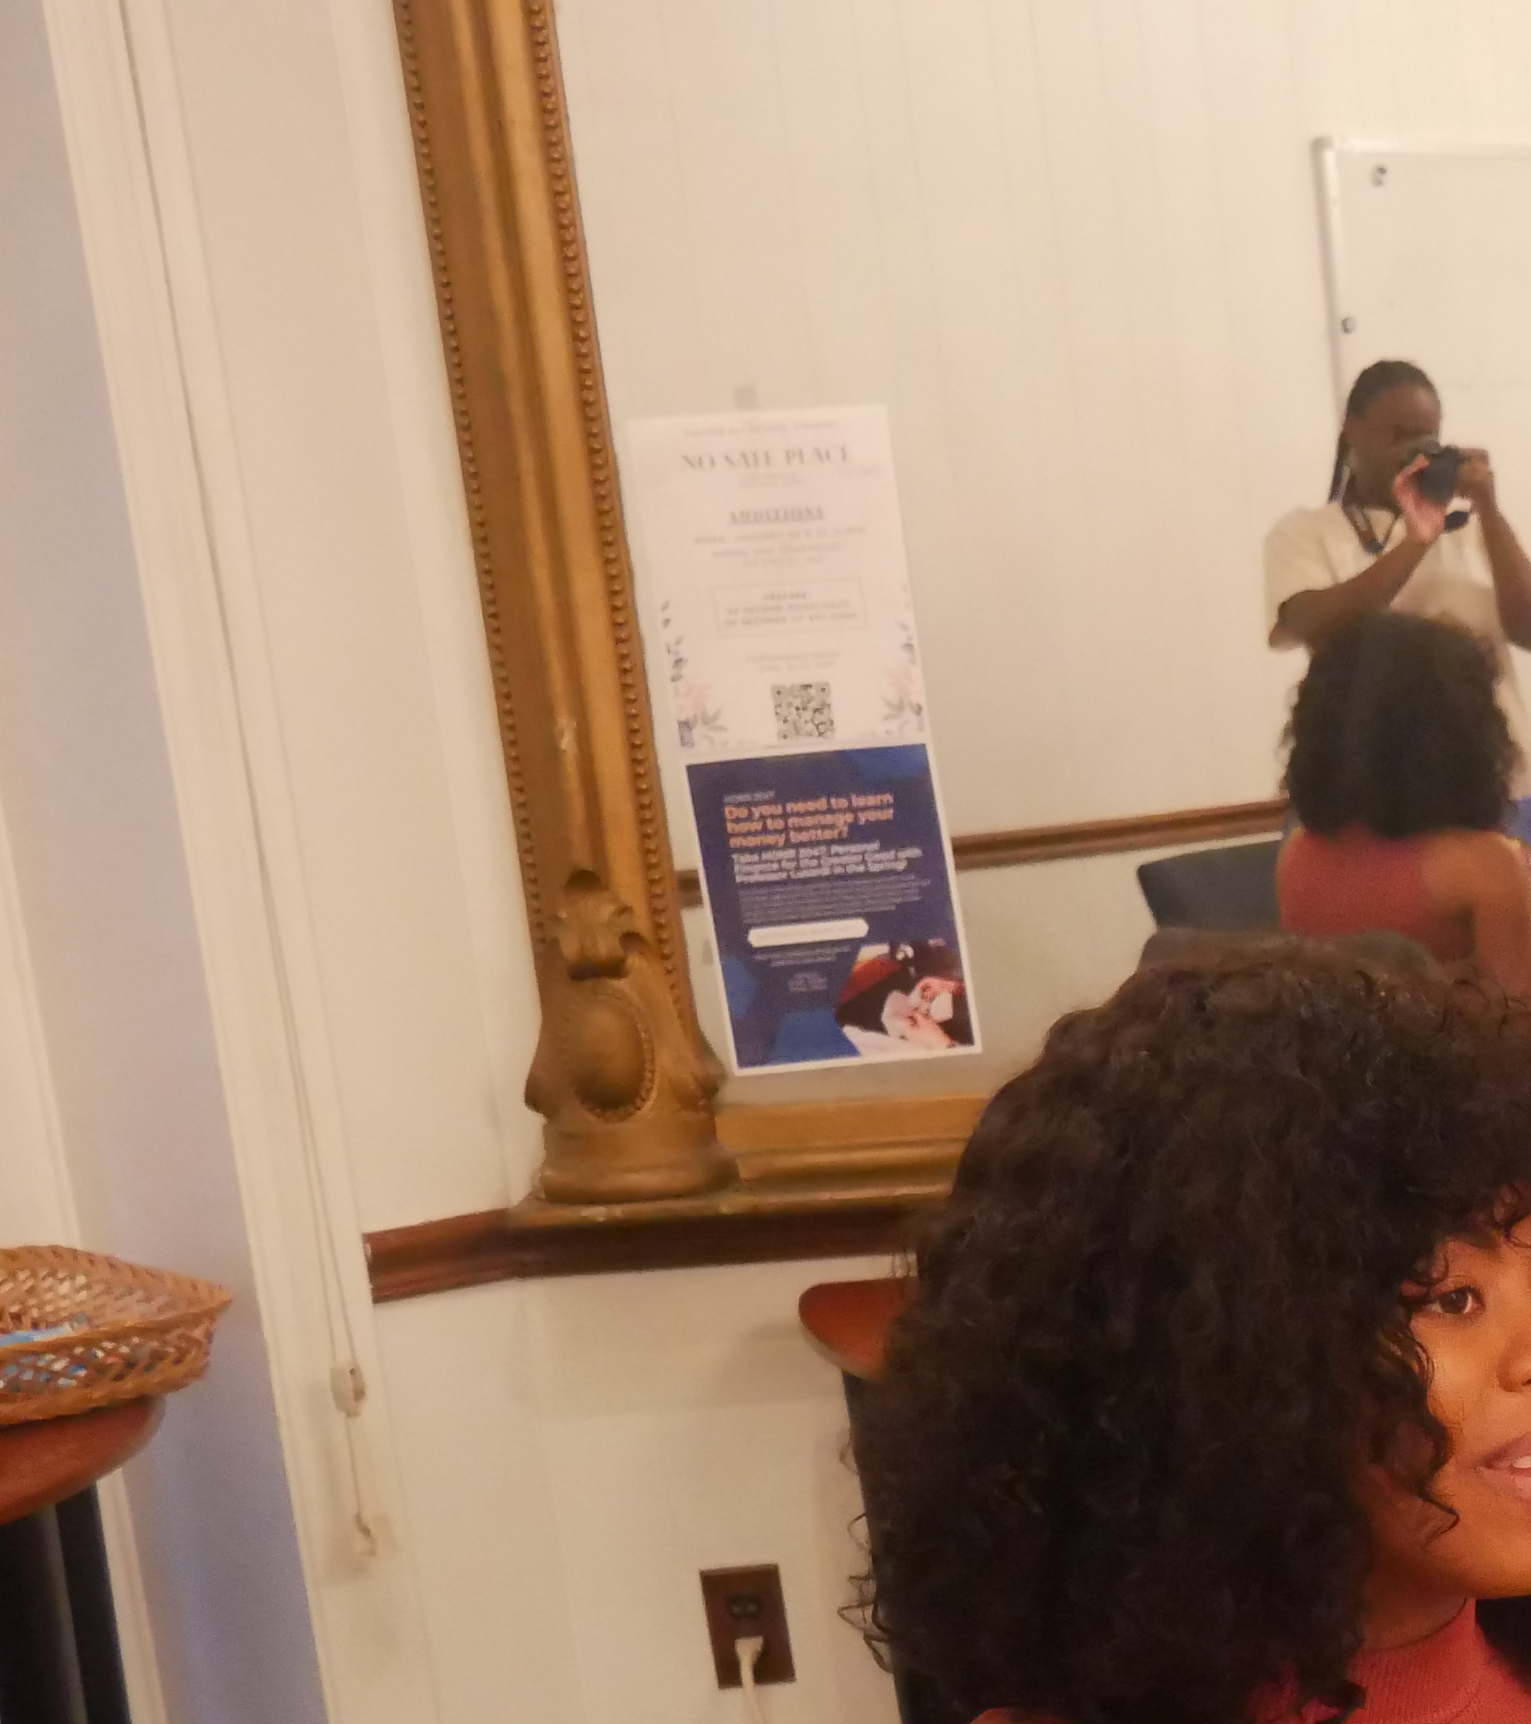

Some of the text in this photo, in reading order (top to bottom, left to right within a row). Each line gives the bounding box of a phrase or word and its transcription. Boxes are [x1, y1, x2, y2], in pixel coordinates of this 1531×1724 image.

[784, 444, 848, 467] PLACE
[724, 805, 748, 820] Do
[750, 803, 782, 820] you
[786, 797, 827, 814] need
[830, 795, 848, 809] to
[851, 790, 893, 807] learn
[726, 806, 893, 834] how to manage your
[729, 831, 785, 852] money
